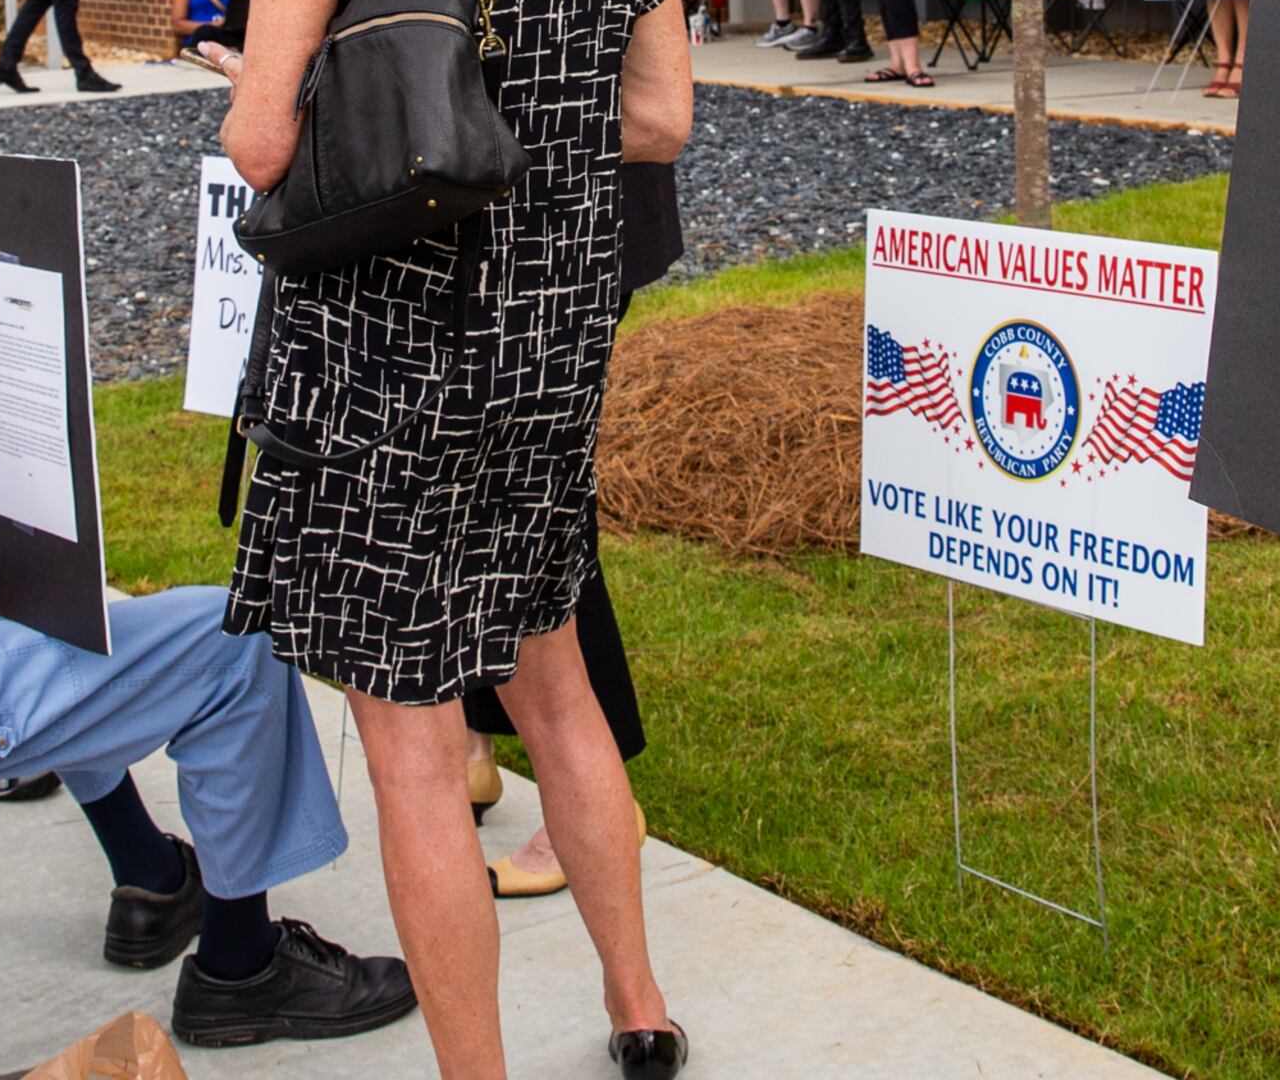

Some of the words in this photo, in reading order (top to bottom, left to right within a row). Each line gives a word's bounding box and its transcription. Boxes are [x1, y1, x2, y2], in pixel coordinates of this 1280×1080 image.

[202, 235, 248, 275] Mrs.
[872, 225, 989, 277] AMERICAN
[998, 240, 1089, 291] VALUES
[1098, 254, 1206, 309] MATTER
[218, 296, 249, 334] Dr.
[984, 327, 1016, 358] COBB
[1017, 326, 1068, 370] COUNTY
[974, 416, 1037, 478] REPUBLICAN
[1042, 430, 1074, 473] PARTY
[868, 479, 927, 519] VOTE
[935, 498, 983, 534] LIKE
[992, 509, 1059, 552] YOUR
[1069, 528, 1195, 587] FREEDOM
[929, 531, 1034, 585] DEPENDS
[1042, 562, 1078, 596] ON
[1088, 575, 1121, 608] IT!
